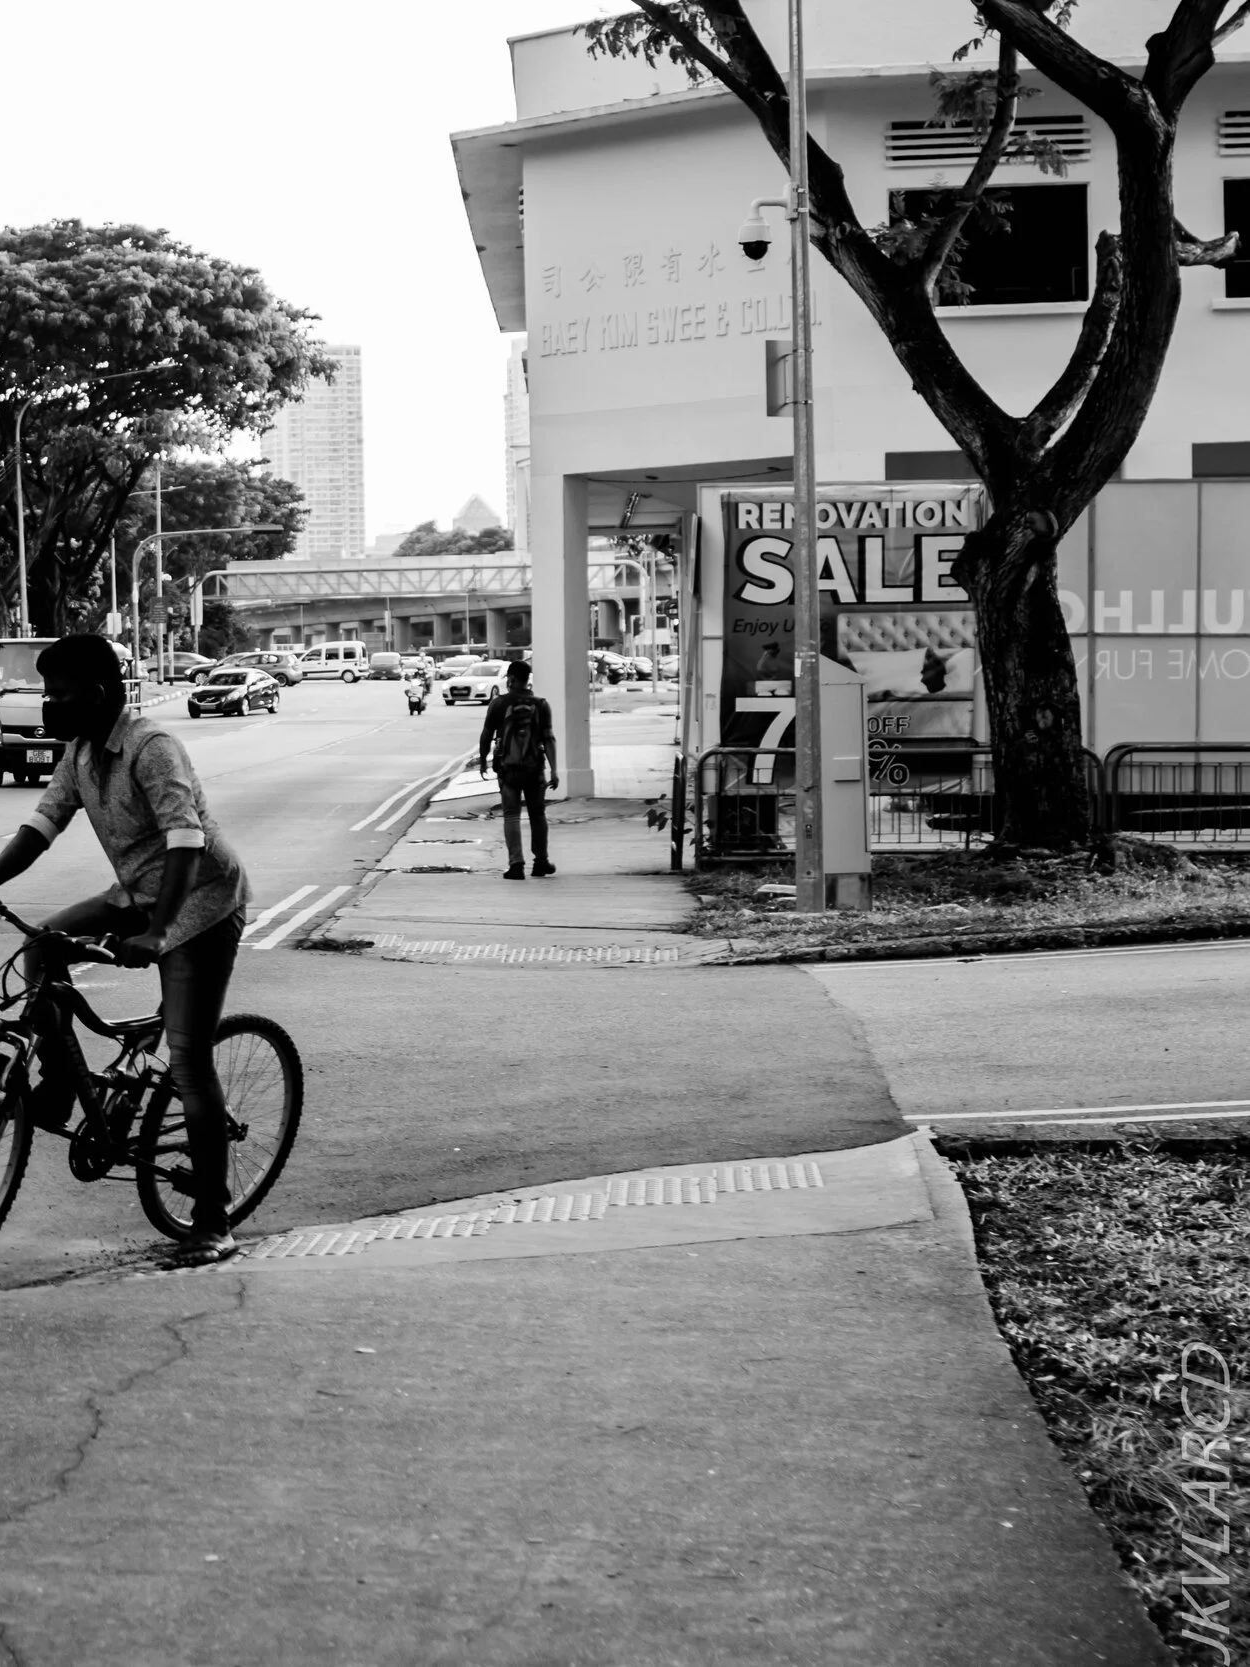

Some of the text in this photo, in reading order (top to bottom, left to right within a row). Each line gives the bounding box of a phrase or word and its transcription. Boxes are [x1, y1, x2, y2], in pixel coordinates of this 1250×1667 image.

[599, 312, 639, 351] KIM
[647, 302, 707, 345] SWEE
[715, 300, 730, 337] &
[738, 535, 970, 605] SALE
[732, 618, 780, 637] Enjoy
[868, 715, 911, 735] OFF
